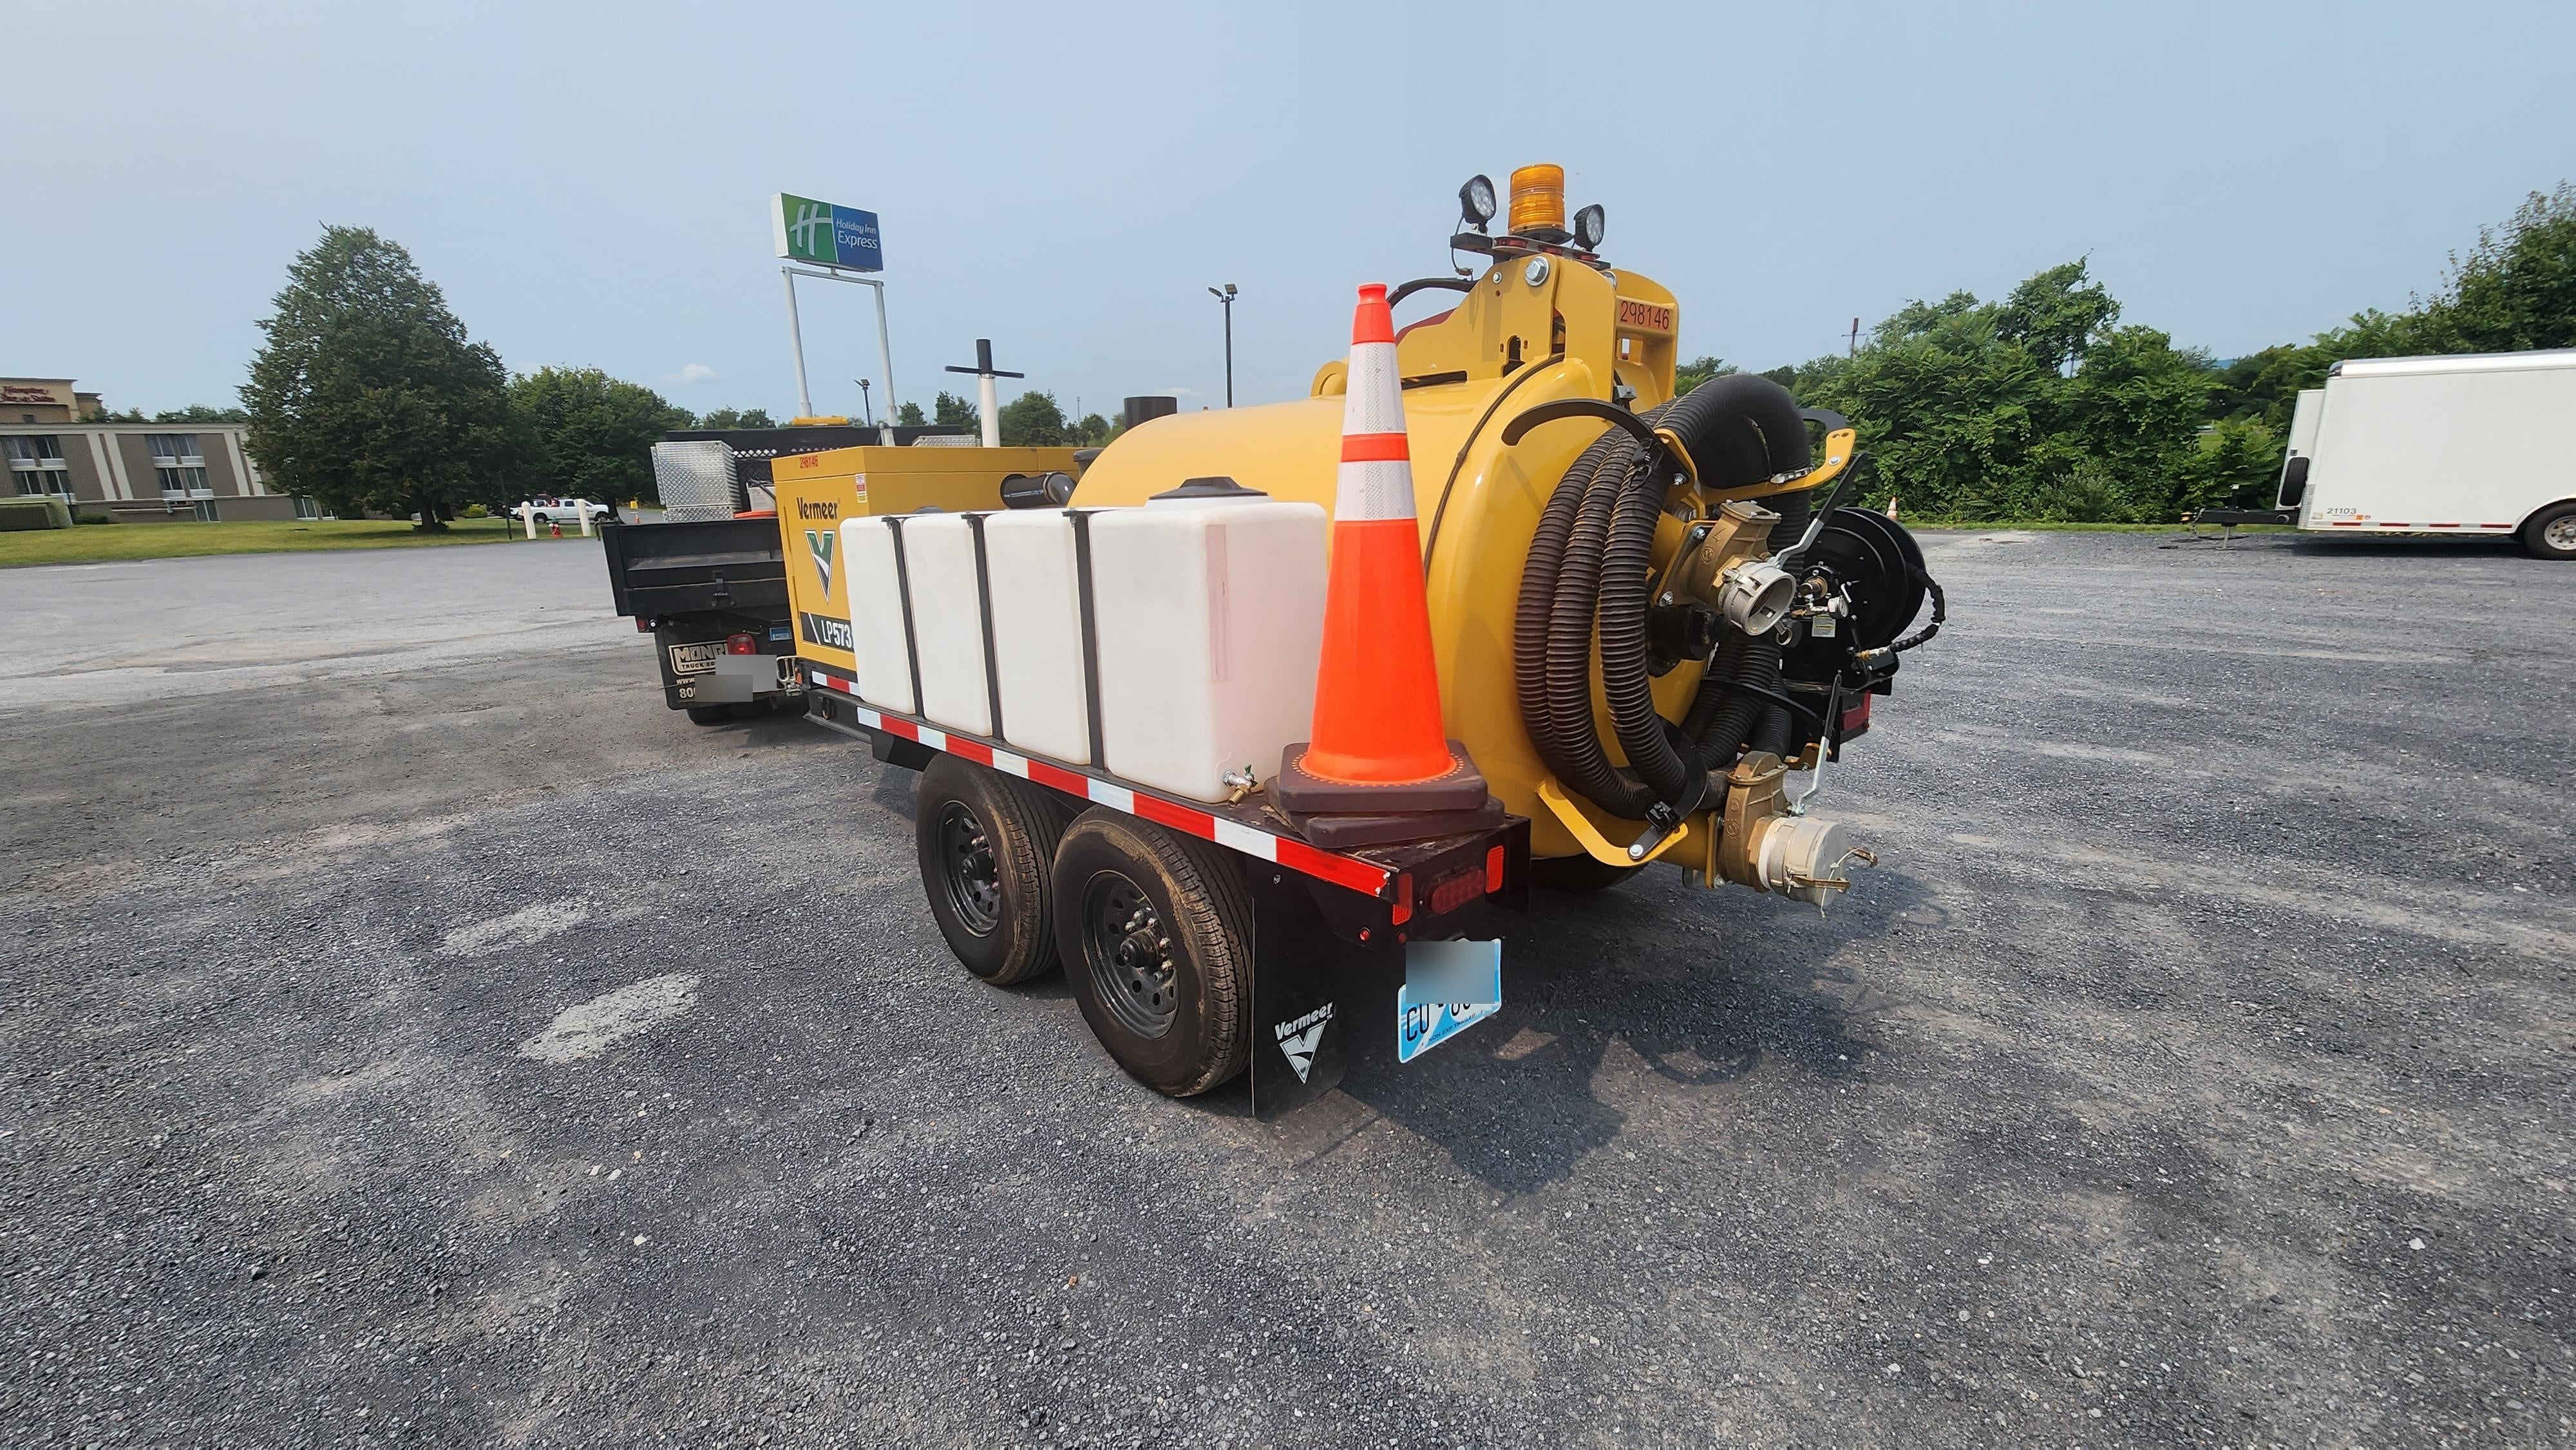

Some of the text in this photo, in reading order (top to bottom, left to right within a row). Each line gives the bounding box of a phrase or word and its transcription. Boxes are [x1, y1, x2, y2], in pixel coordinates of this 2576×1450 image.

[837, 218, 876, 234] Holiday Inn
[838, 231, 877, 249] Express
[1620, 300, 1669, 330] 298146
[799, 455, 819, 469] 298146
[797, 497, 838, 520] Vermeer
[820, 619, 853, 648] LP573
[673, 643, 728, 664] MONR
[679, 686, 696, 699] 80
[1274, 1001, 1333, 1040] Vermeer
[1428, 1031, 1441, 1042] NON
[1454, 1013, 1476, 1028] TRAILER
